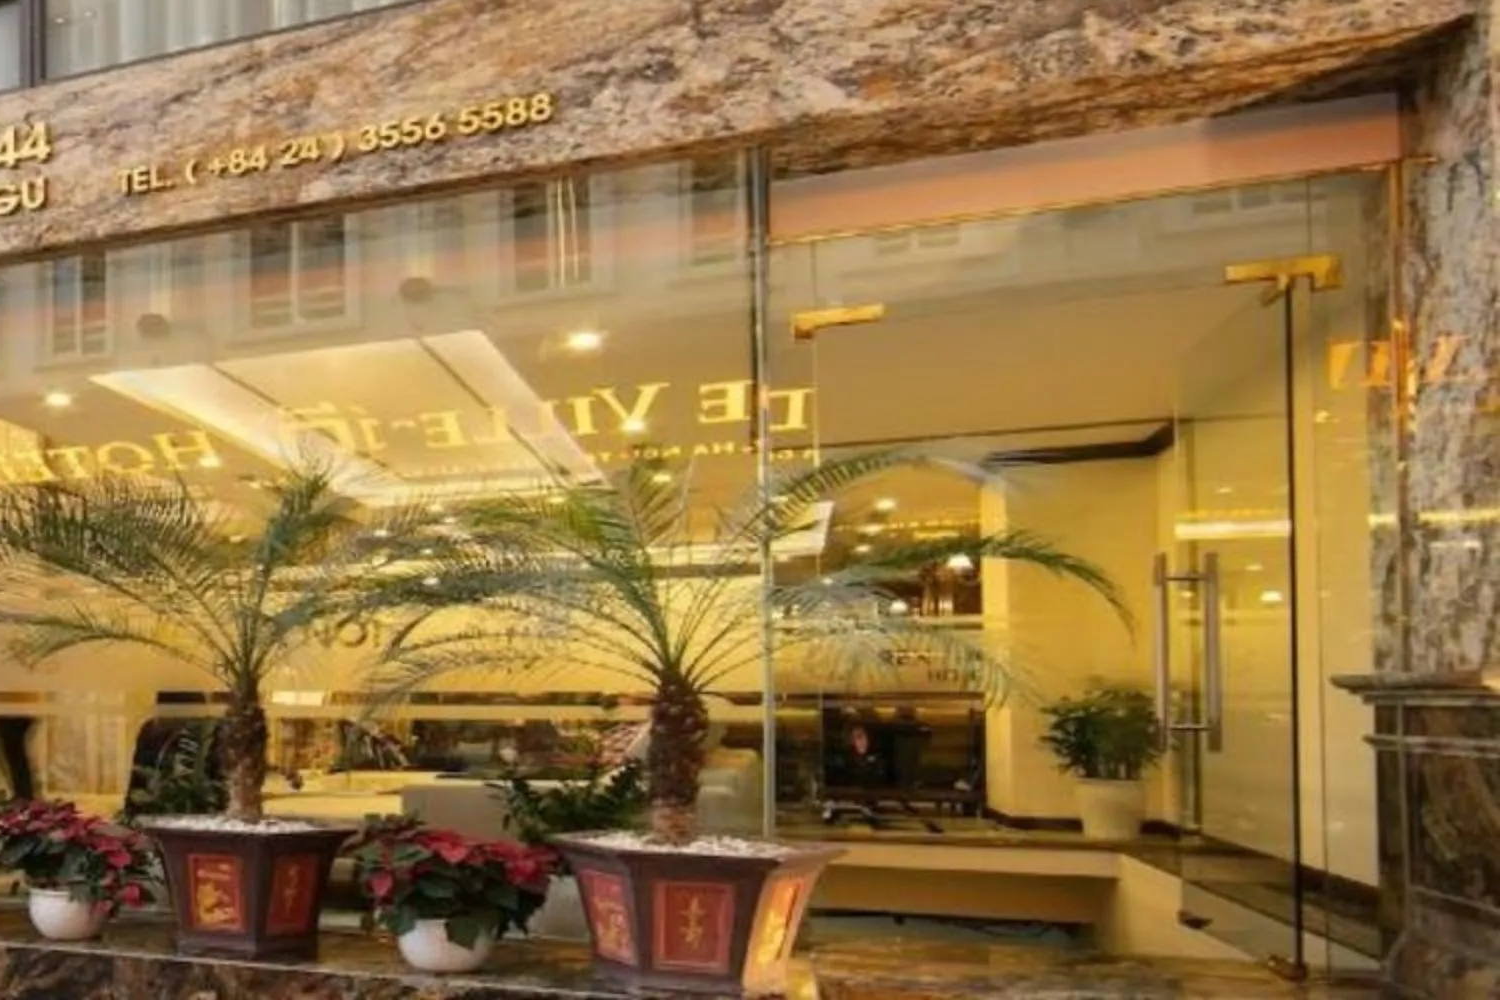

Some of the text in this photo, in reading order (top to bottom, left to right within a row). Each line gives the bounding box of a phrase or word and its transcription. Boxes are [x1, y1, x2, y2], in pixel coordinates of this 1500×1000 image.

[116, 164, 175, 194] TEL.
[357, 113, 448, 152] 3556
[457, 91, 554, 135] 5588
